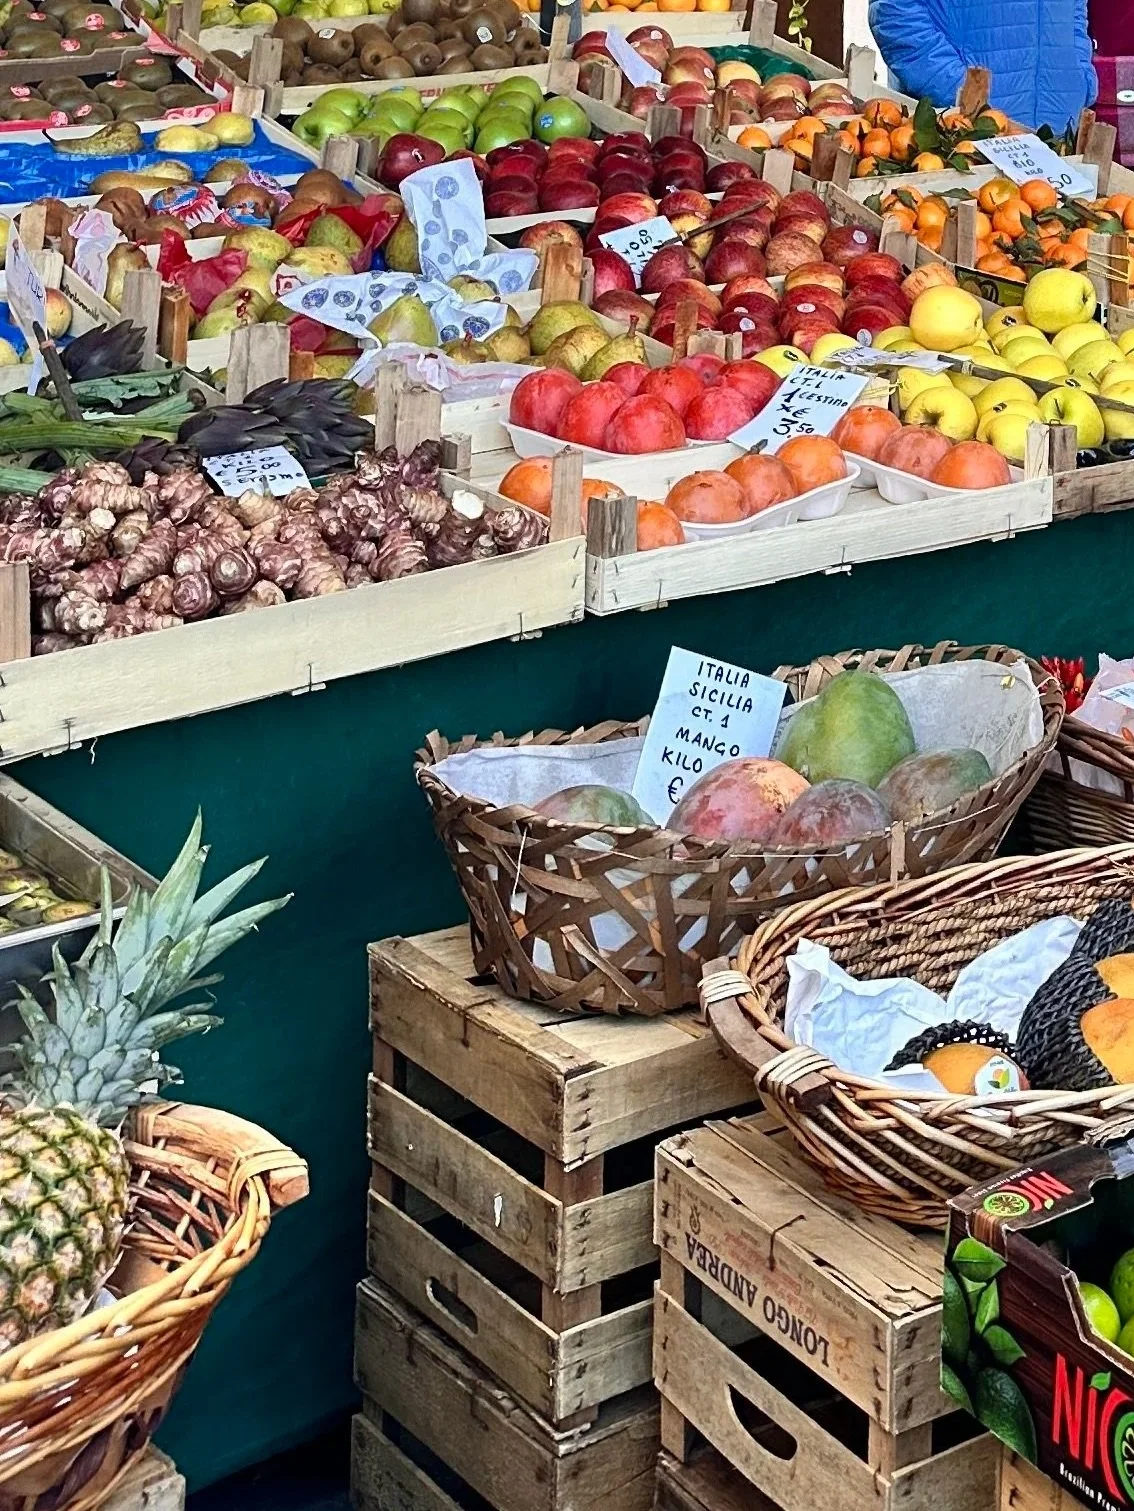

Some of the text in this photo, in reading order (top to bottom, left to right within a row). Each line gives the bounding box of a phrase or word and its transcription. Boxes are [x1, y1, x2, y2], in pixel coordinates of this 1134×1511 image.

[983, 136, 1021, 147] ITALIA
[799, 367, 846, 381] ITALIA
[697, 660, 750, 688] ITALIA
[689, 681, 753, 714] SICILIA
[720, 714, 730, 728] 1
[675, 726, 740, 757] MANGO
[661, 746, 703, 774] KILO
[667, 776, 684, 805] €
[685, 1231, 759, 1308] ANDREA
[762, 1294, 831, 1369] LONGO
[1060, 1462, 1095, 1499] Brazilian
